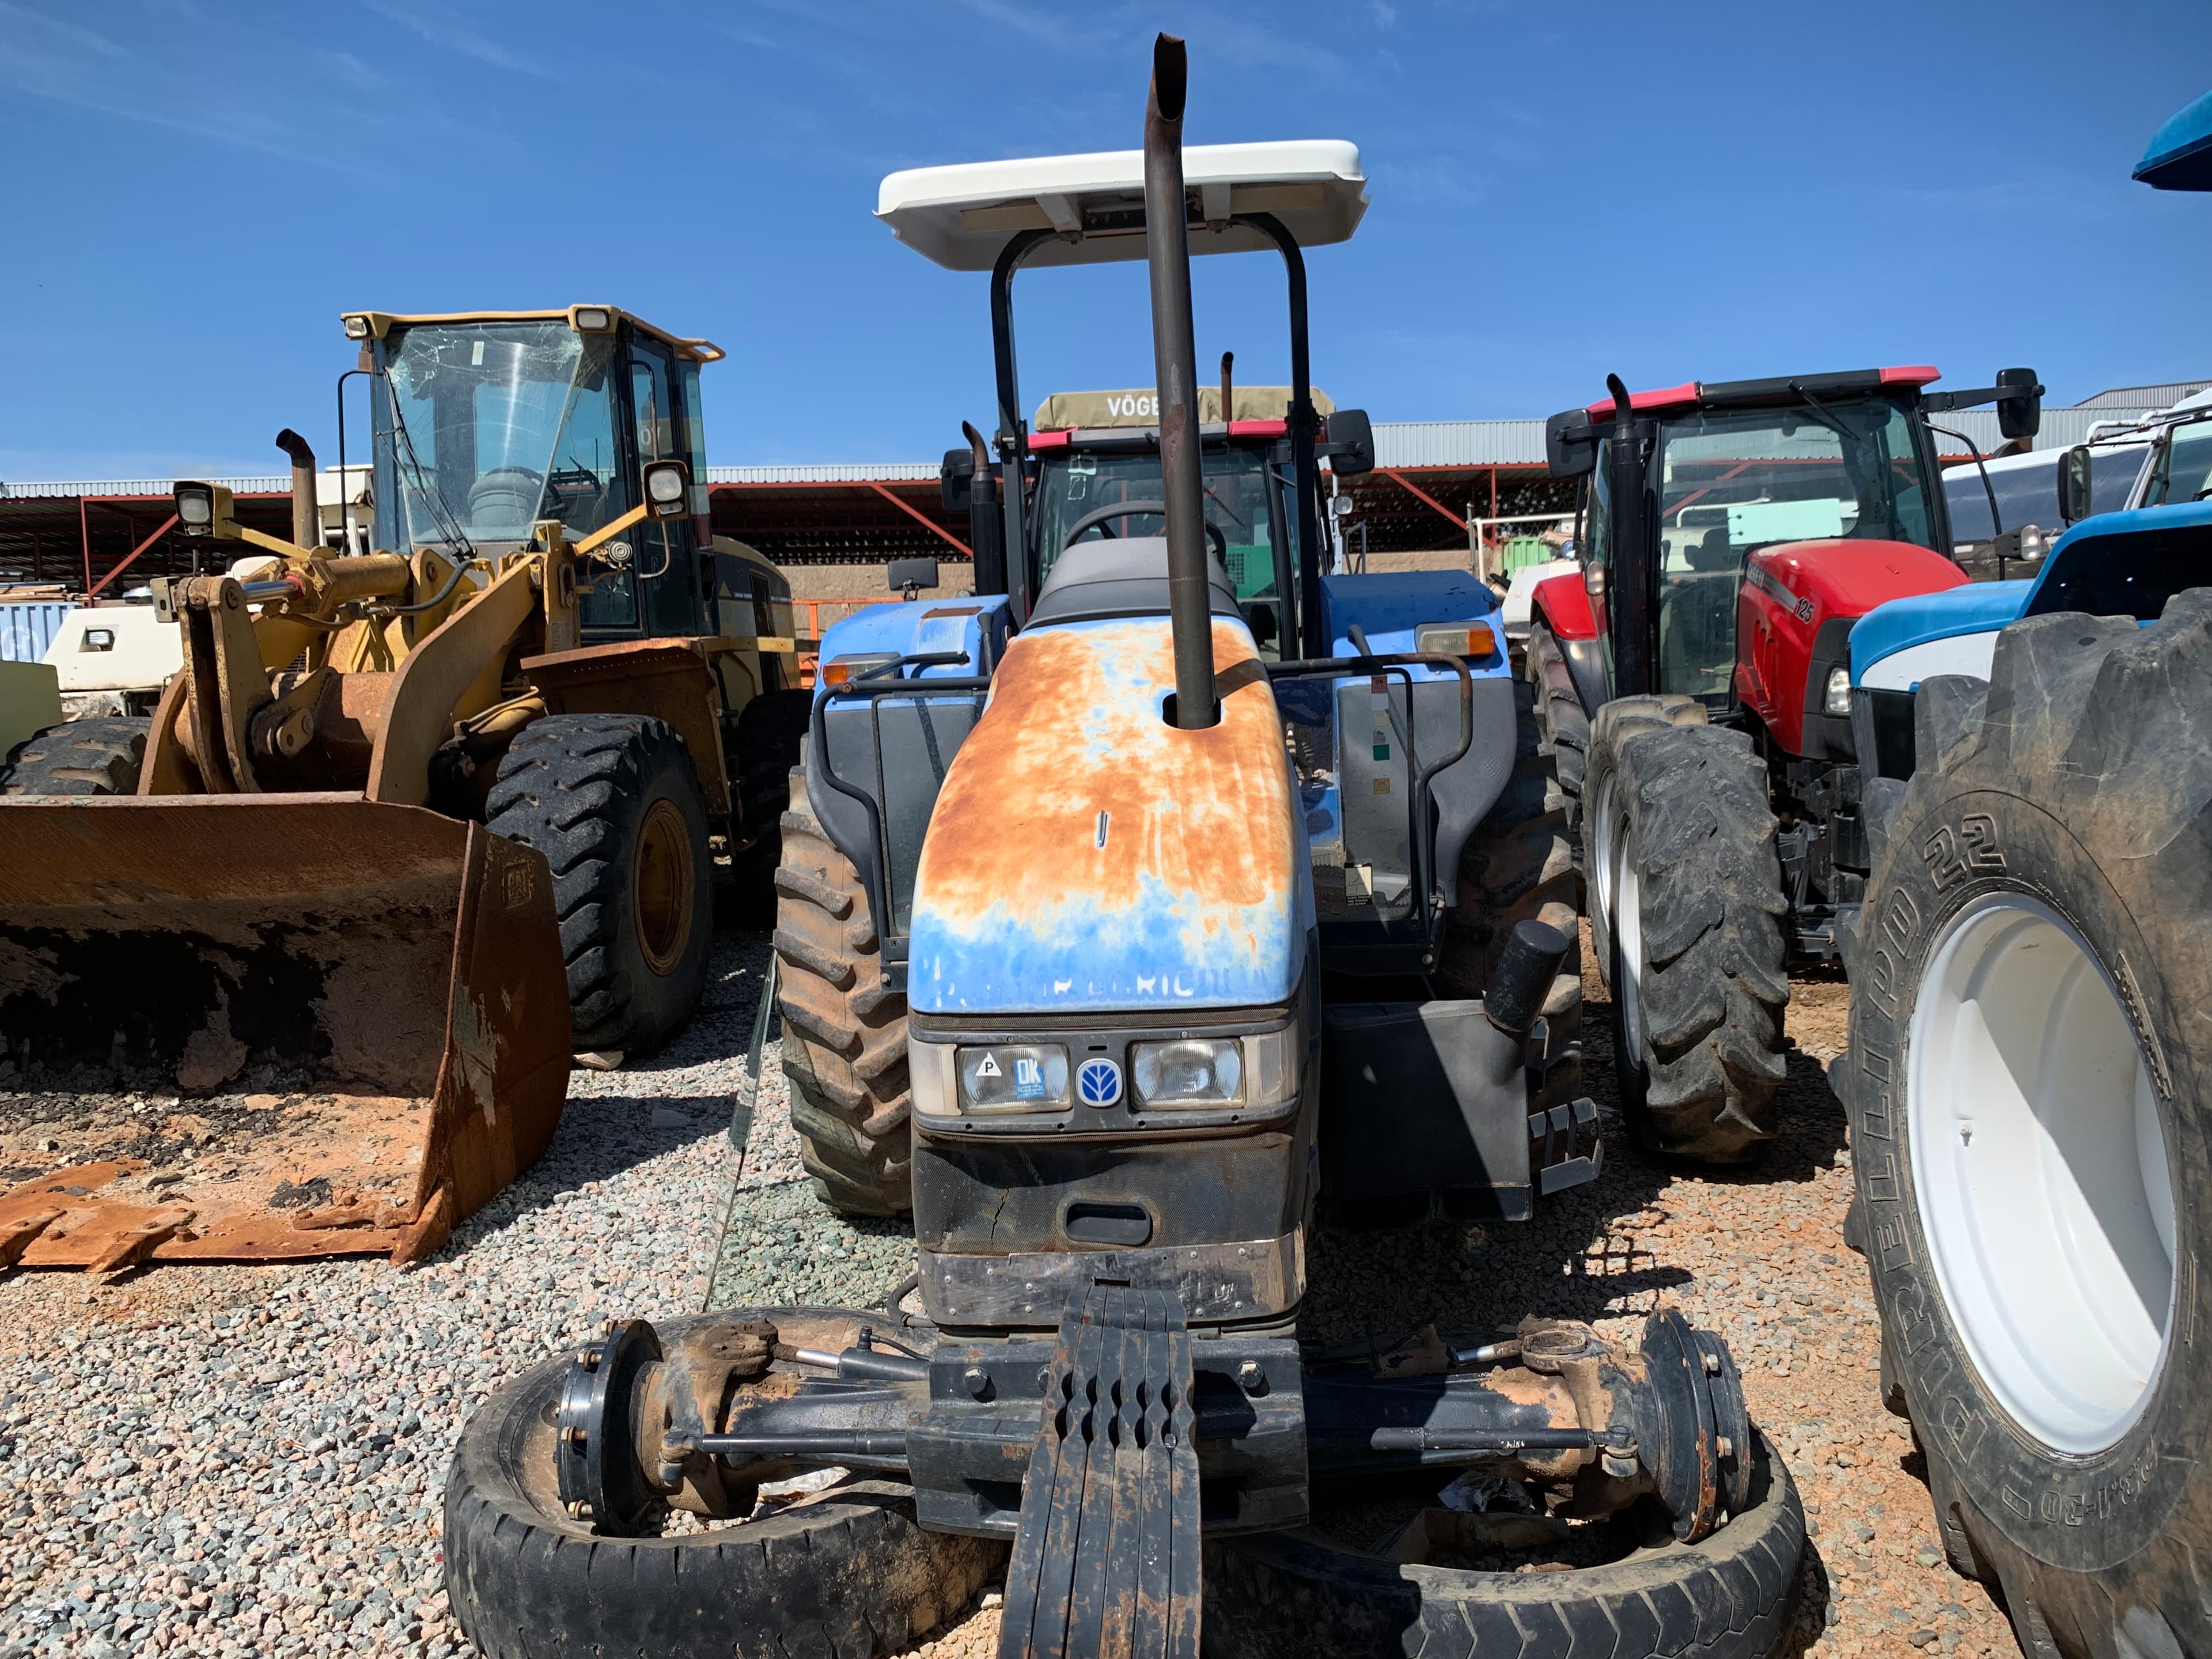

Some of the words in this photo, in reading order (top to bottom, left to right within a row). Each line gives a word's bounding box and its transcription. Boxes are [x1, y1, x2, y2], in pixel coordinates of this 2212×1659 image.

[1796, 598, 1815, 623] 125
[1924, 813, 2007, 895] 22
[985, 1062, 994, 1073] P
[1017, 1059, 1042, 1085] OK
[1863, 1047, 1989, 1465] PIRELLI
